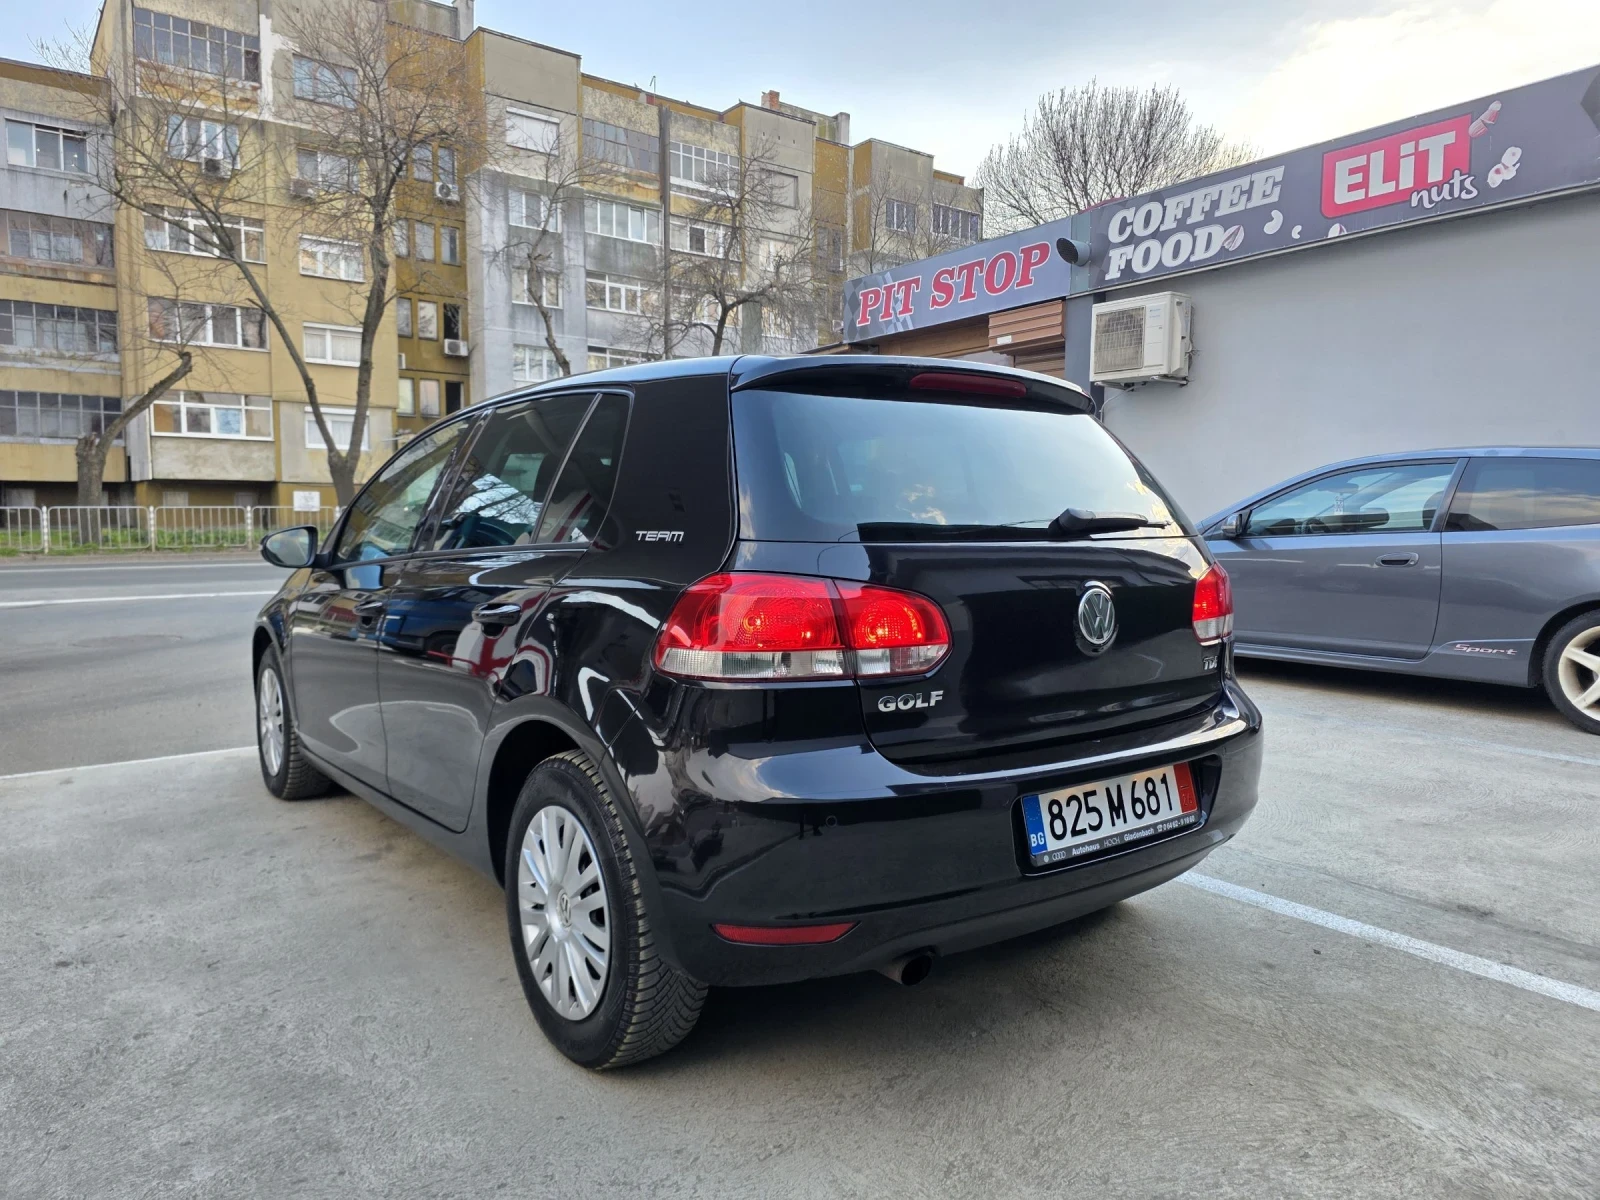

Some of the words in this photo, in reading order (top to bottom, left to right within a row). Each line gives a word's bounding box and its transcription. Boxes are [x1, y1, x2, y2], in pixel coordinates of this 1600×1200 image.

[1107, 165, 1285, 244] COFFEE
[1411, 169, 1478, 209] nuts
[1104, 224, 1225, 281] FOOD
[857, 275, 922, 327] PIT
[929, 241, 1051, 310] STOP
[636, 530, 685, 542] TEAM
[1453, 643, 1518, 655] Sport
[877, 690, 944, 712] GOLF
[1047, 789, 1104, 841] 825
[1105, 783, 1128, 828] M
[1130, 773, 1173, 821] 681
[1030, 831, 1045, 847] BG
[1072, 842, 1100, 856] Autohaus
